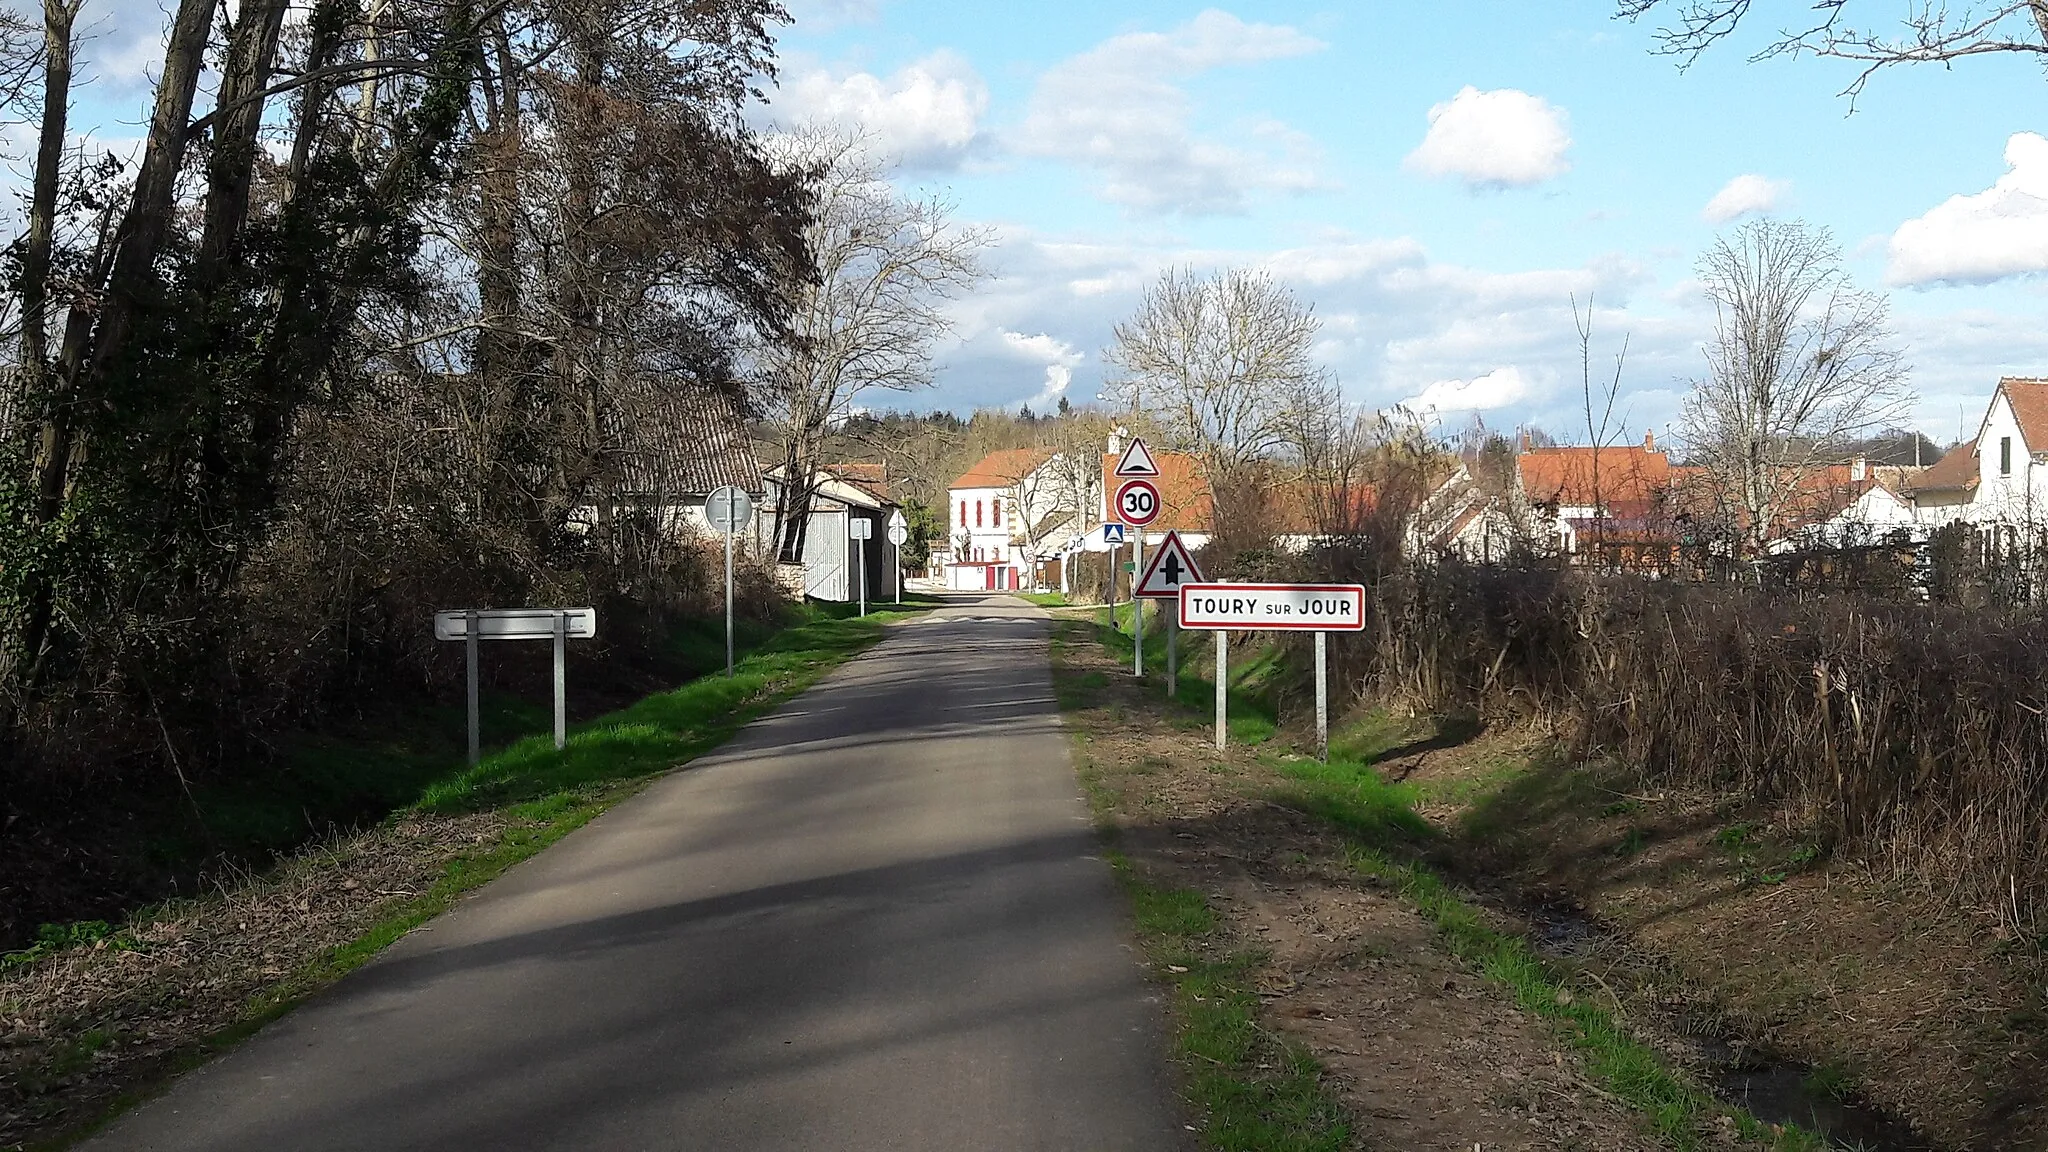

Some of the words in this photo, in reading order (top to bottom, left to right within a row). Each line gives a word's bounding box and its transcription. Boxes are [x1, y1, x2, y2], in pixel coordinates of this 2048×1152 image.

[1125, 492, 1153, 513] 30
[1192, 598, 1258, 614] TOURY
[1265, 604, 1292, 615] SUR
[1298, 599, 1352, 616] JOUR
